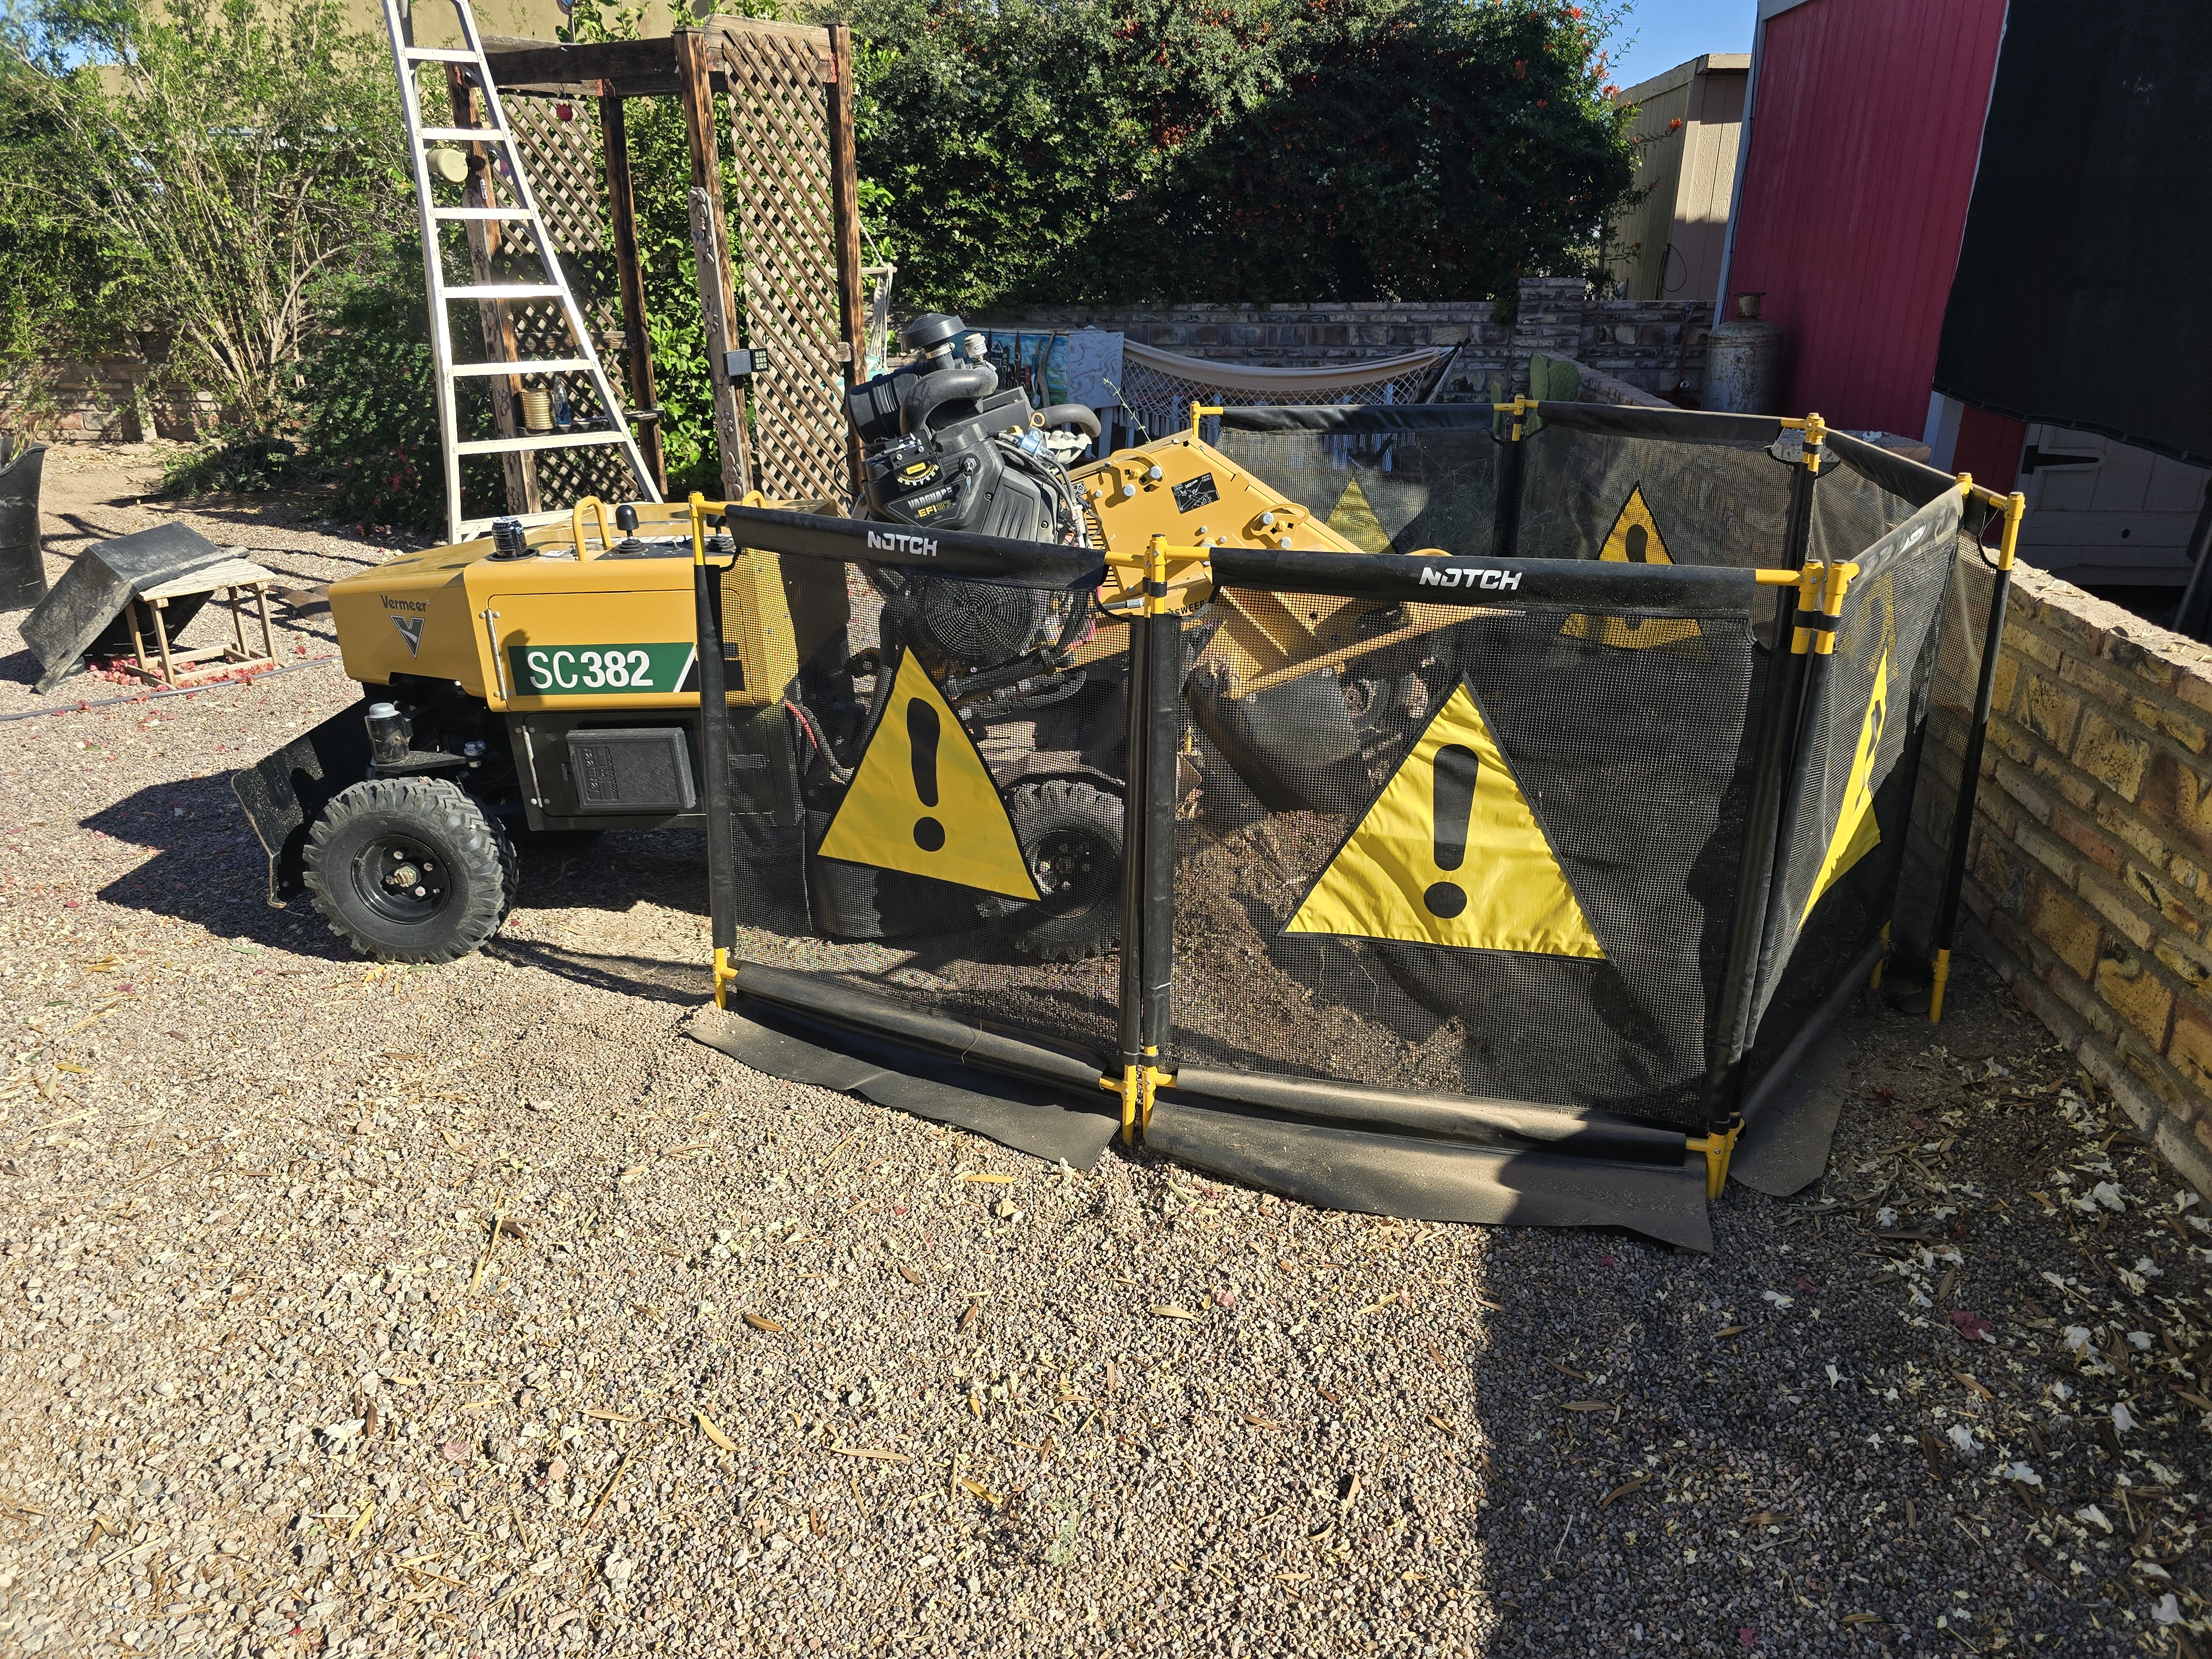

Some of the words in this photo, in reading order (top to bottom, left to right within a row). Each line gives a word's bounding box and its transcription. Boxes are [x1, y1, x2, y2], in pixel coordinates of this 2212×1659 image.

[868, 530, 938, 557] NOTCH
[1418, 567, 1522, 590] NOTCH
[380, 595, 426, 612] Vermeer
[527, 650, 654, 689] SC382
